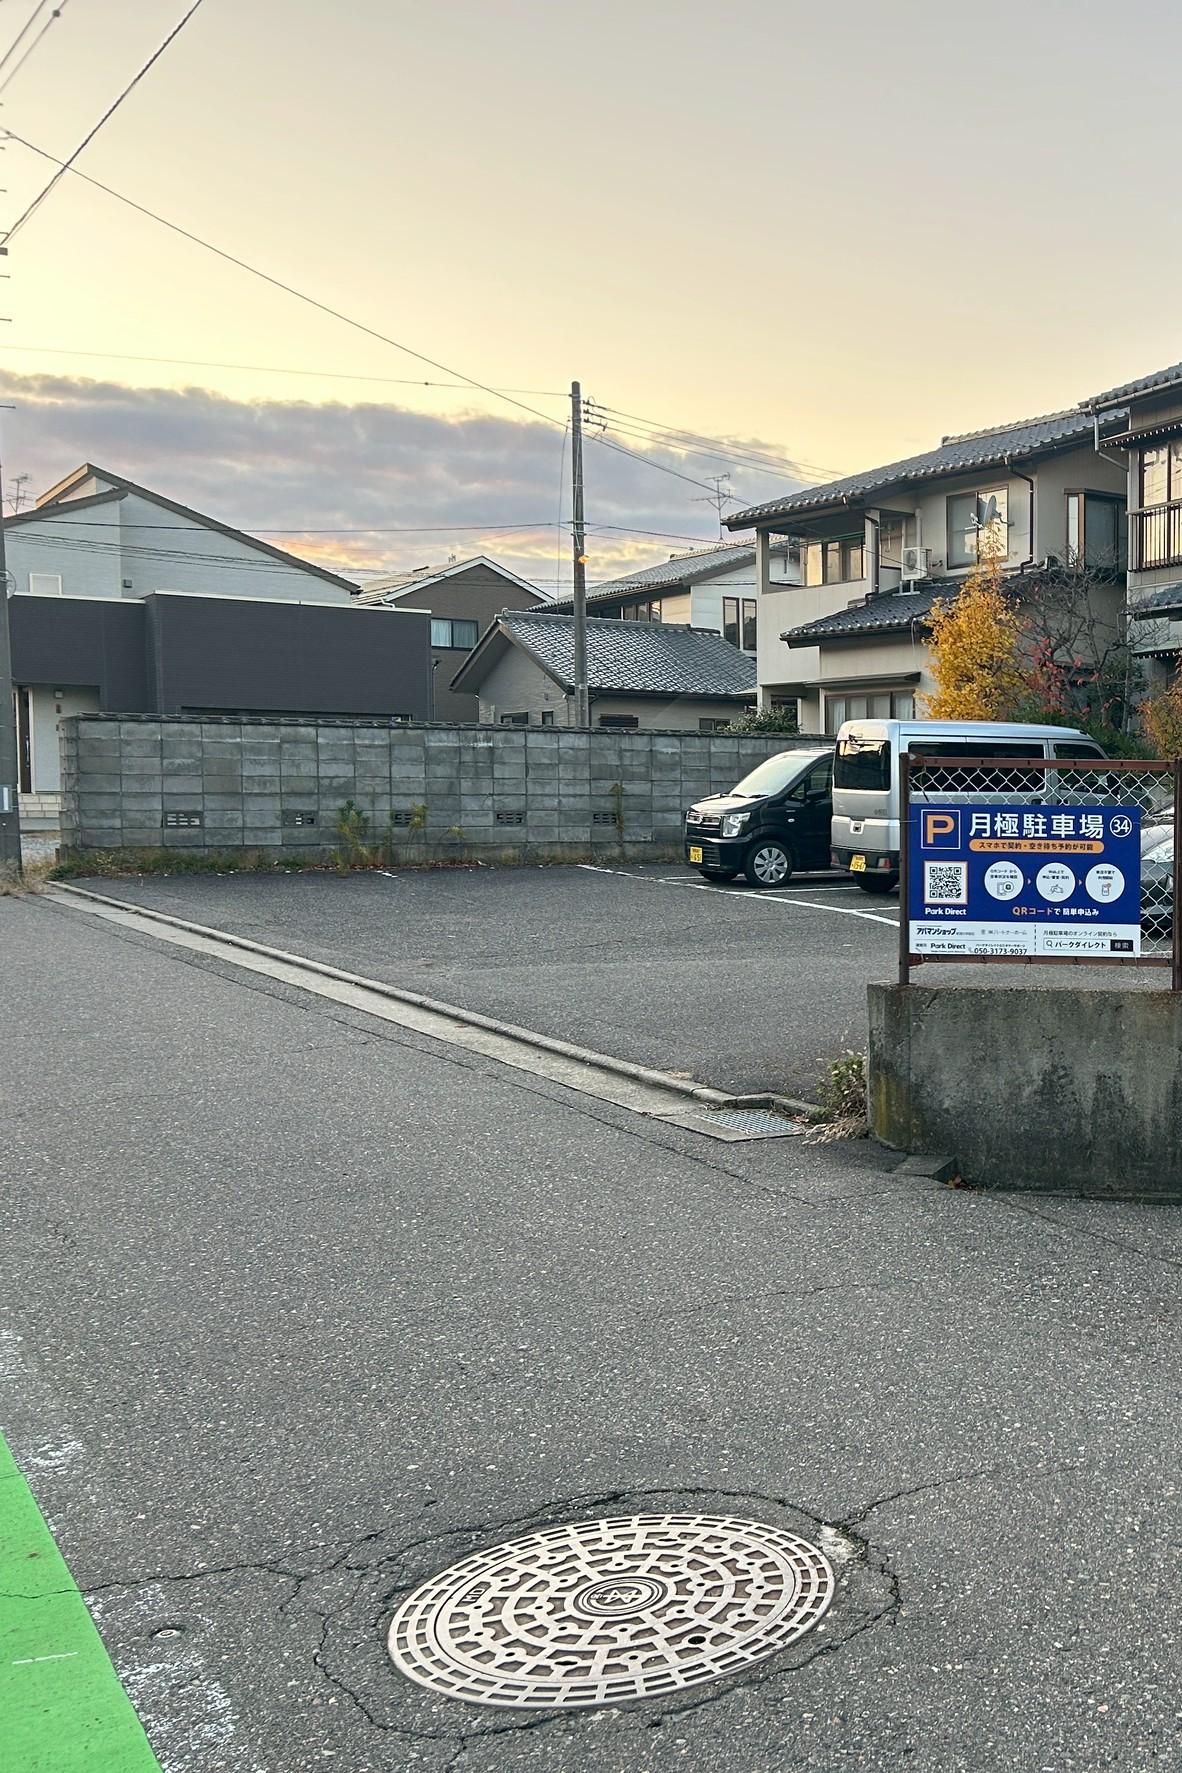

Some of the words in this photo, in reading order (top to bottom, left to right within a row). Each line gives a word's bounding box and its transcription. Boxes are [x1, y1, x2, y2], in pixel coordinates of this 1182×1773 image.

[926, 815, 955, 844] P
[968, 812, 1105, 839] 月極駐車場
[978, 842, 1094, 851] スマホで契約・空き待ち予約が可能
[924, 907, 944, 916] Park
[944, 907, 967, 916] Direct
[916, 927, 957, 936] アパマンショップ
[1055, 940, 1106, 949] パークダイレクト
[974, 947, 1028, 955] 050-3173-9037
